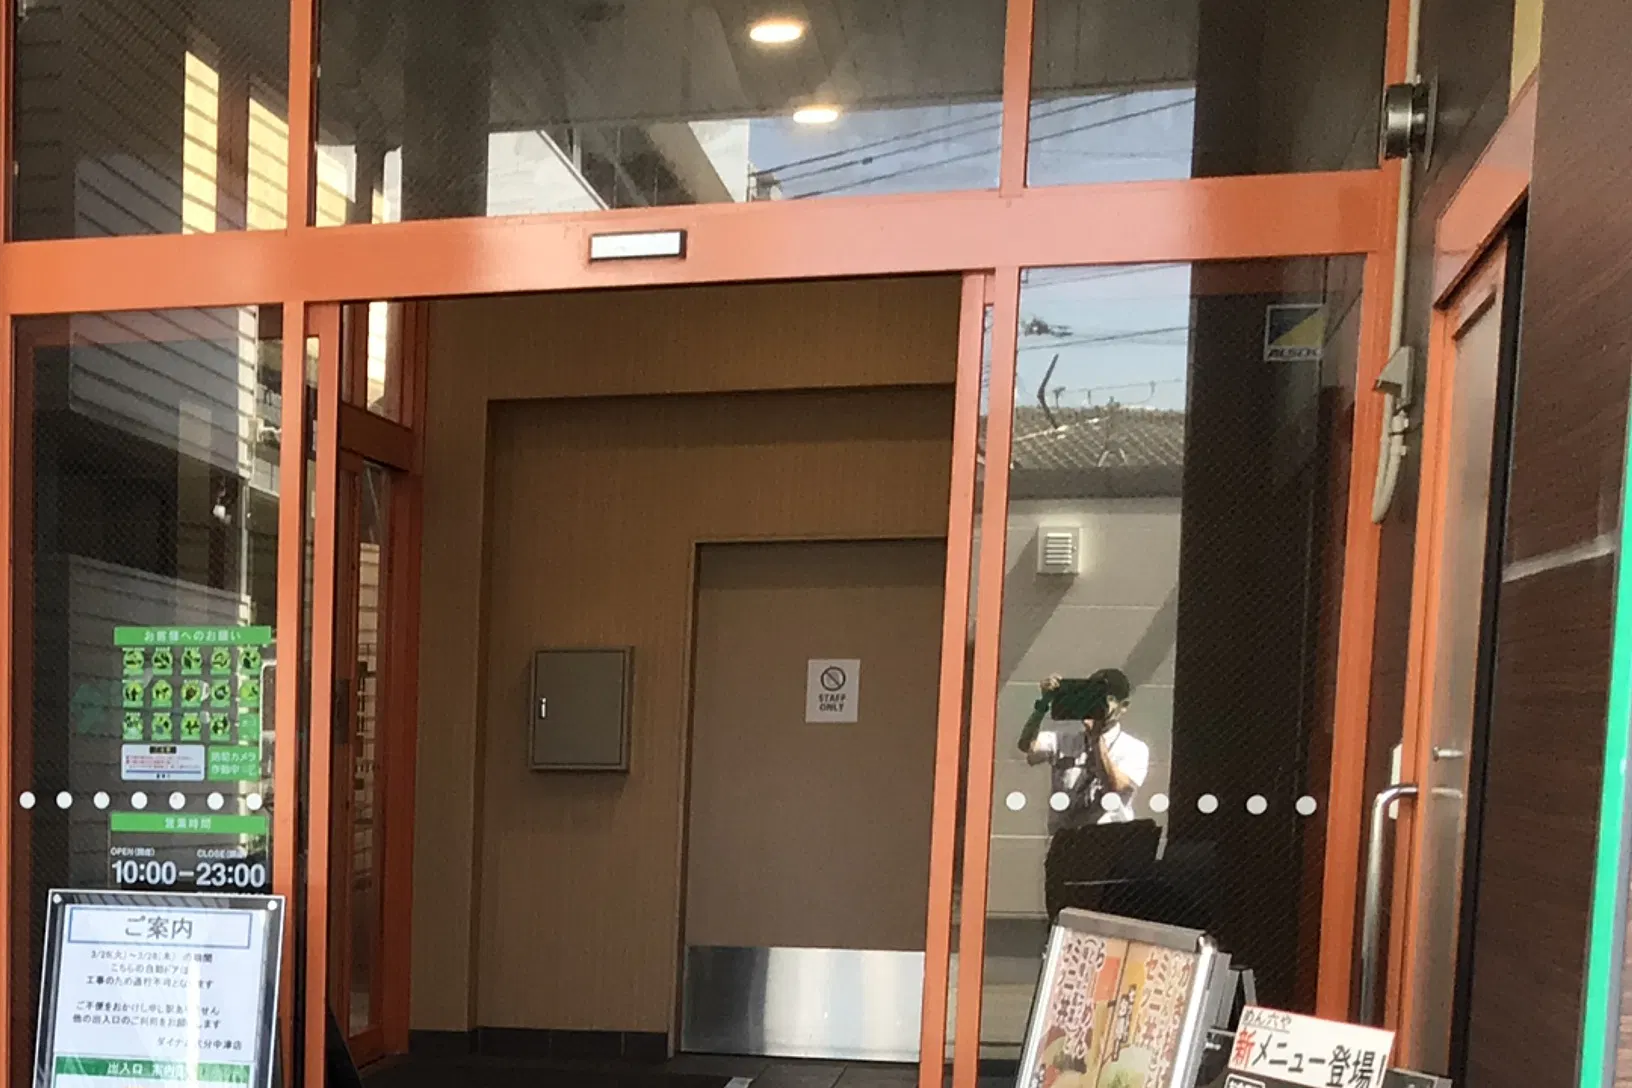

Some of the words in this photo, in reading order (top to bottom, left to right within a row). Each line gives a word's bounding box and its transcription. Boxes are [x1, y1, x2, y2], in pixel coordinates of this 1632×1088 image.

[819, 694, 846, 703] STAFF
[819, 703, 844, 712] ONLY
[125, 913, 195, 940] ご案内
[86, 975, 214, 989] 工事のため通行不可となます
[76, 1001, 220, 1015] ご不便をおかけし申し訳あせん
[73, 1014, 221, 1029] 他の出入口のご利用をお願ます
[1243, 1008, 1292, 1028] めん六や
[157, 1036, 243, 1050] ダイナ分中津店
[107, 1062, 144, 1075] 出入口
